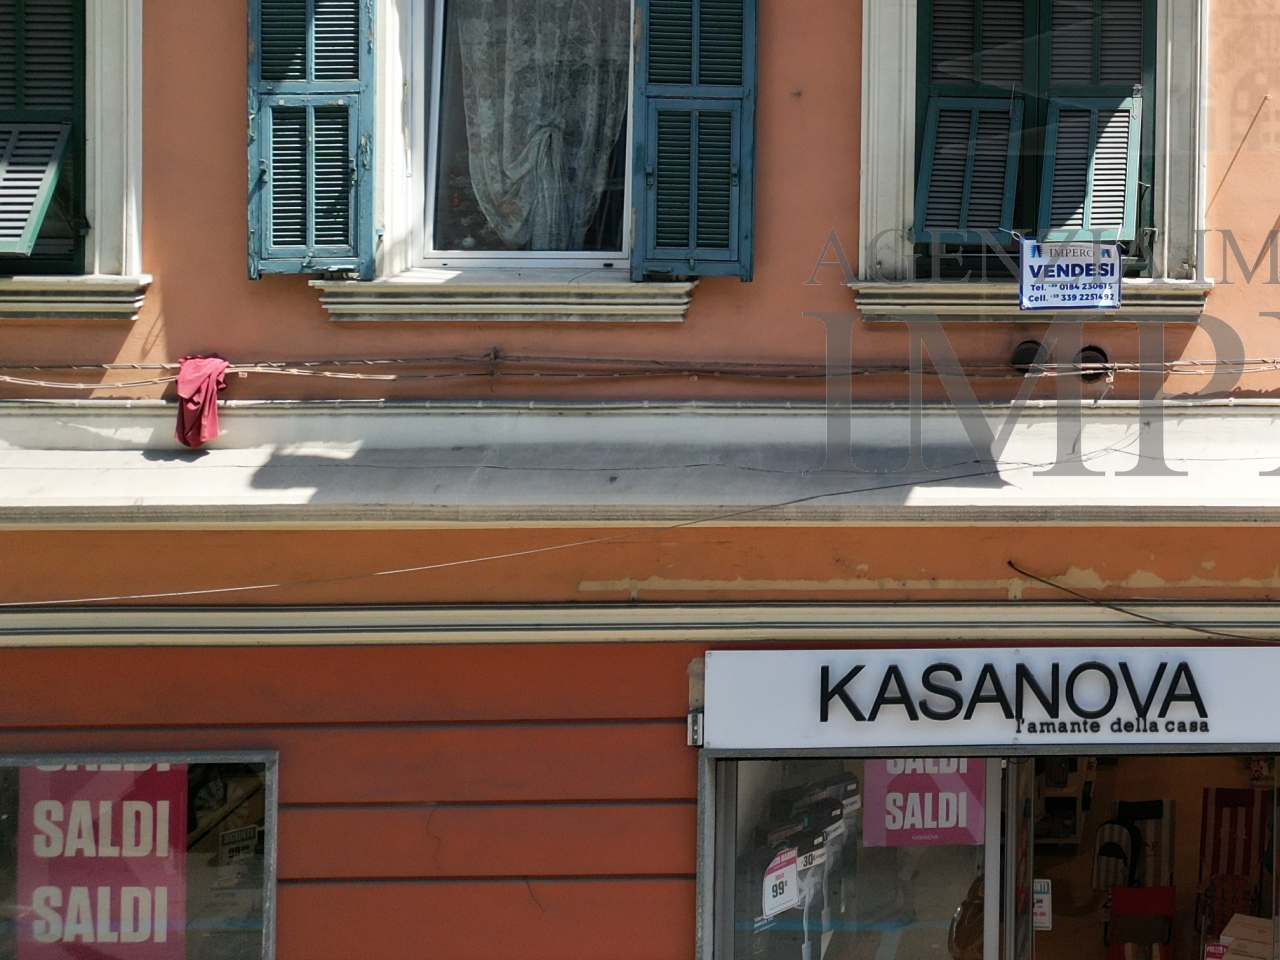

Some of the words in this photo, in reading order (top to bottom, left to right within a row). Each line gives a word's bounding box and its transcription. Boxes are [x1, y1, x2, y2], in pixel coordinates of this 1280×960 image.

[1049, 248, 1095, 258] IMPERO
[1028, 263, 1115, 278] VENDESI
[1028, 294, 1049, 302] Cell.
[1061, 293, 1077, 301] 339
[1079, 293, 1114, 301] 2251492
[819, 660, 1209, 723] KASANOVA
[1015, 718, 1101, 734] l'amante
[1110, 717, 1160, 733] della
[1164, 719, 1210, 733] casa
[885, 791, 967, 830] SALDI
[32, 799, 170, 858] SALDI
[32, 886, 168, 944] SALDI
